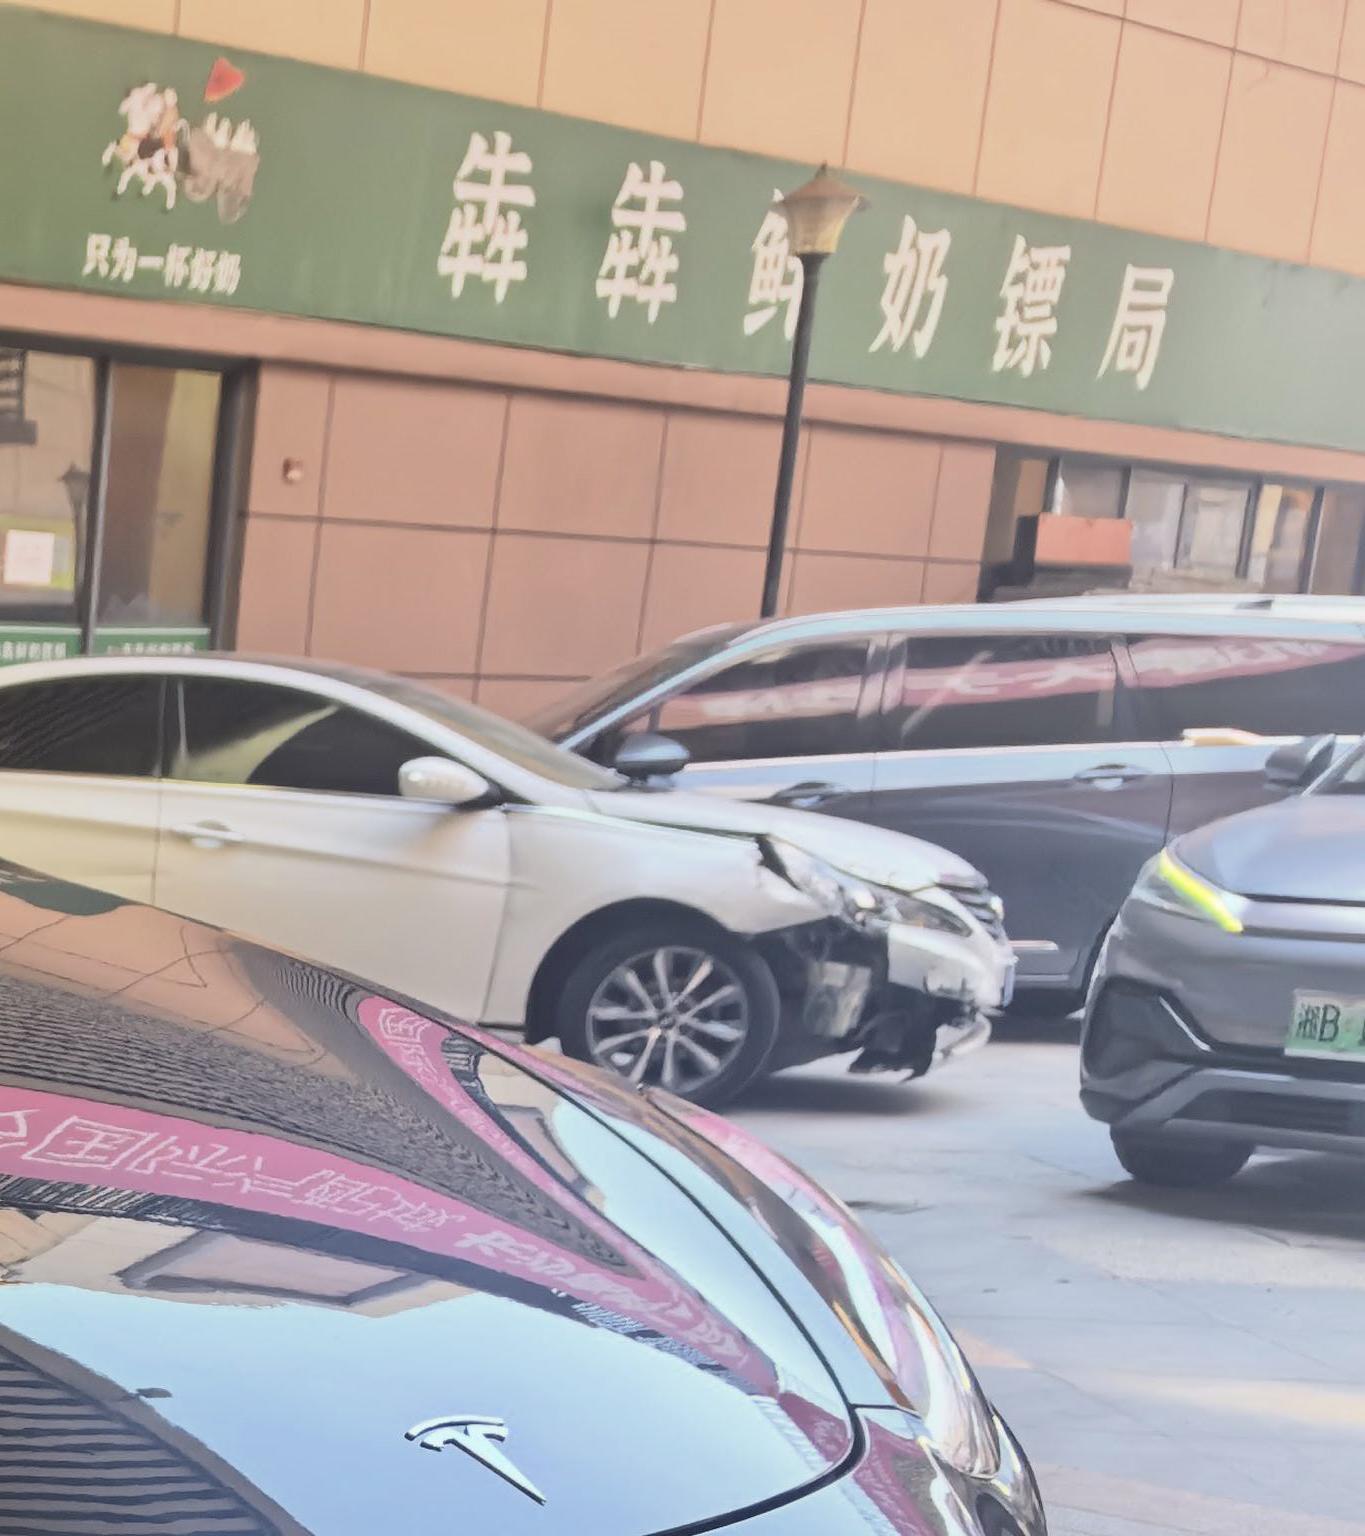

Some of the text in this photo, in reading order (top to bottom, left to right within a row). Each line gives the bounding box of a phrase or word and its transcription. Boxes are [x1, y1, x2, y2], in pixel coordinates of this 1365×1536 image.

[82, 232, 242, 297] 只为一杯好奶
[1295, 1003, 1365, 1046] 湘B
